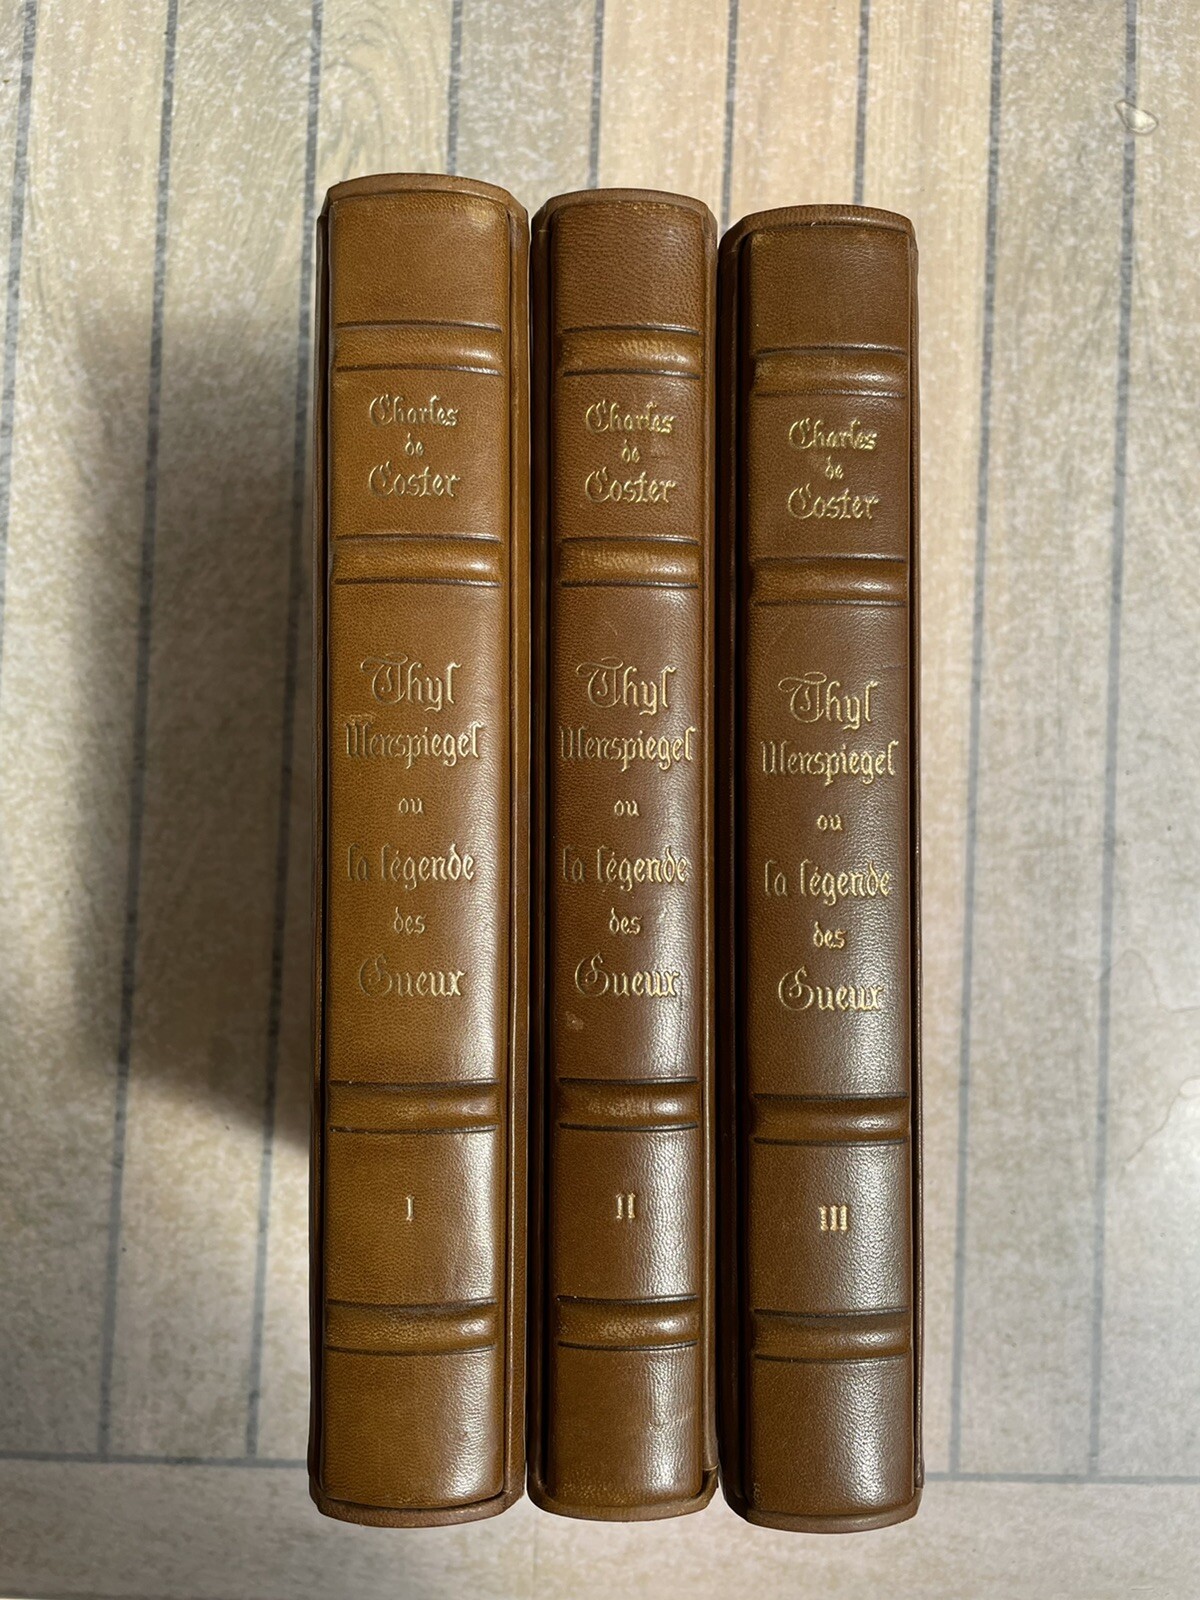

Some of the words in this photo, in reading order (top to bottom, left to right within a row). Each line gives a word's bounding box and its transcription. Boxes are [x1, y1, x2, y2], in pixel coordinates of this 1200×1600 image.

[368, 394, 458, 427] Charles
[584, 400, 674, 434] Charles
[404, 432, 424, 456] de
[621, 438, 640, 462] de
[788, 417, 877, 451] Charles
[367, 461, 461, 498] Coster
[825, 455, 844, 480] de
[584, 467, 677, 503] Coster
[786, 485, 879, 520] Coster
[360, 654, 461, 711] Thyl
[575, 657, 675, 715] Thyl
[778, 671, 877, 729] Thyl
[397, 796, 423, 815] ou
[613, 798, 639, 817] ou
[816, 813, 842, 832] ou
[347, 846, 370, 882] la
[562, 847, 585, 883] la
[764, 860, 787, 897] la
[393, 906, 426, 935] des
[609, 908, 641, 935] des
[813, 922, 845, 949] des
[358, 953, 465, 997] Gueux
[574, 953, 680, 997] Gueux
[778, 966, 884, 1012] Gueux
[819, 1205, 848, 1231] III
